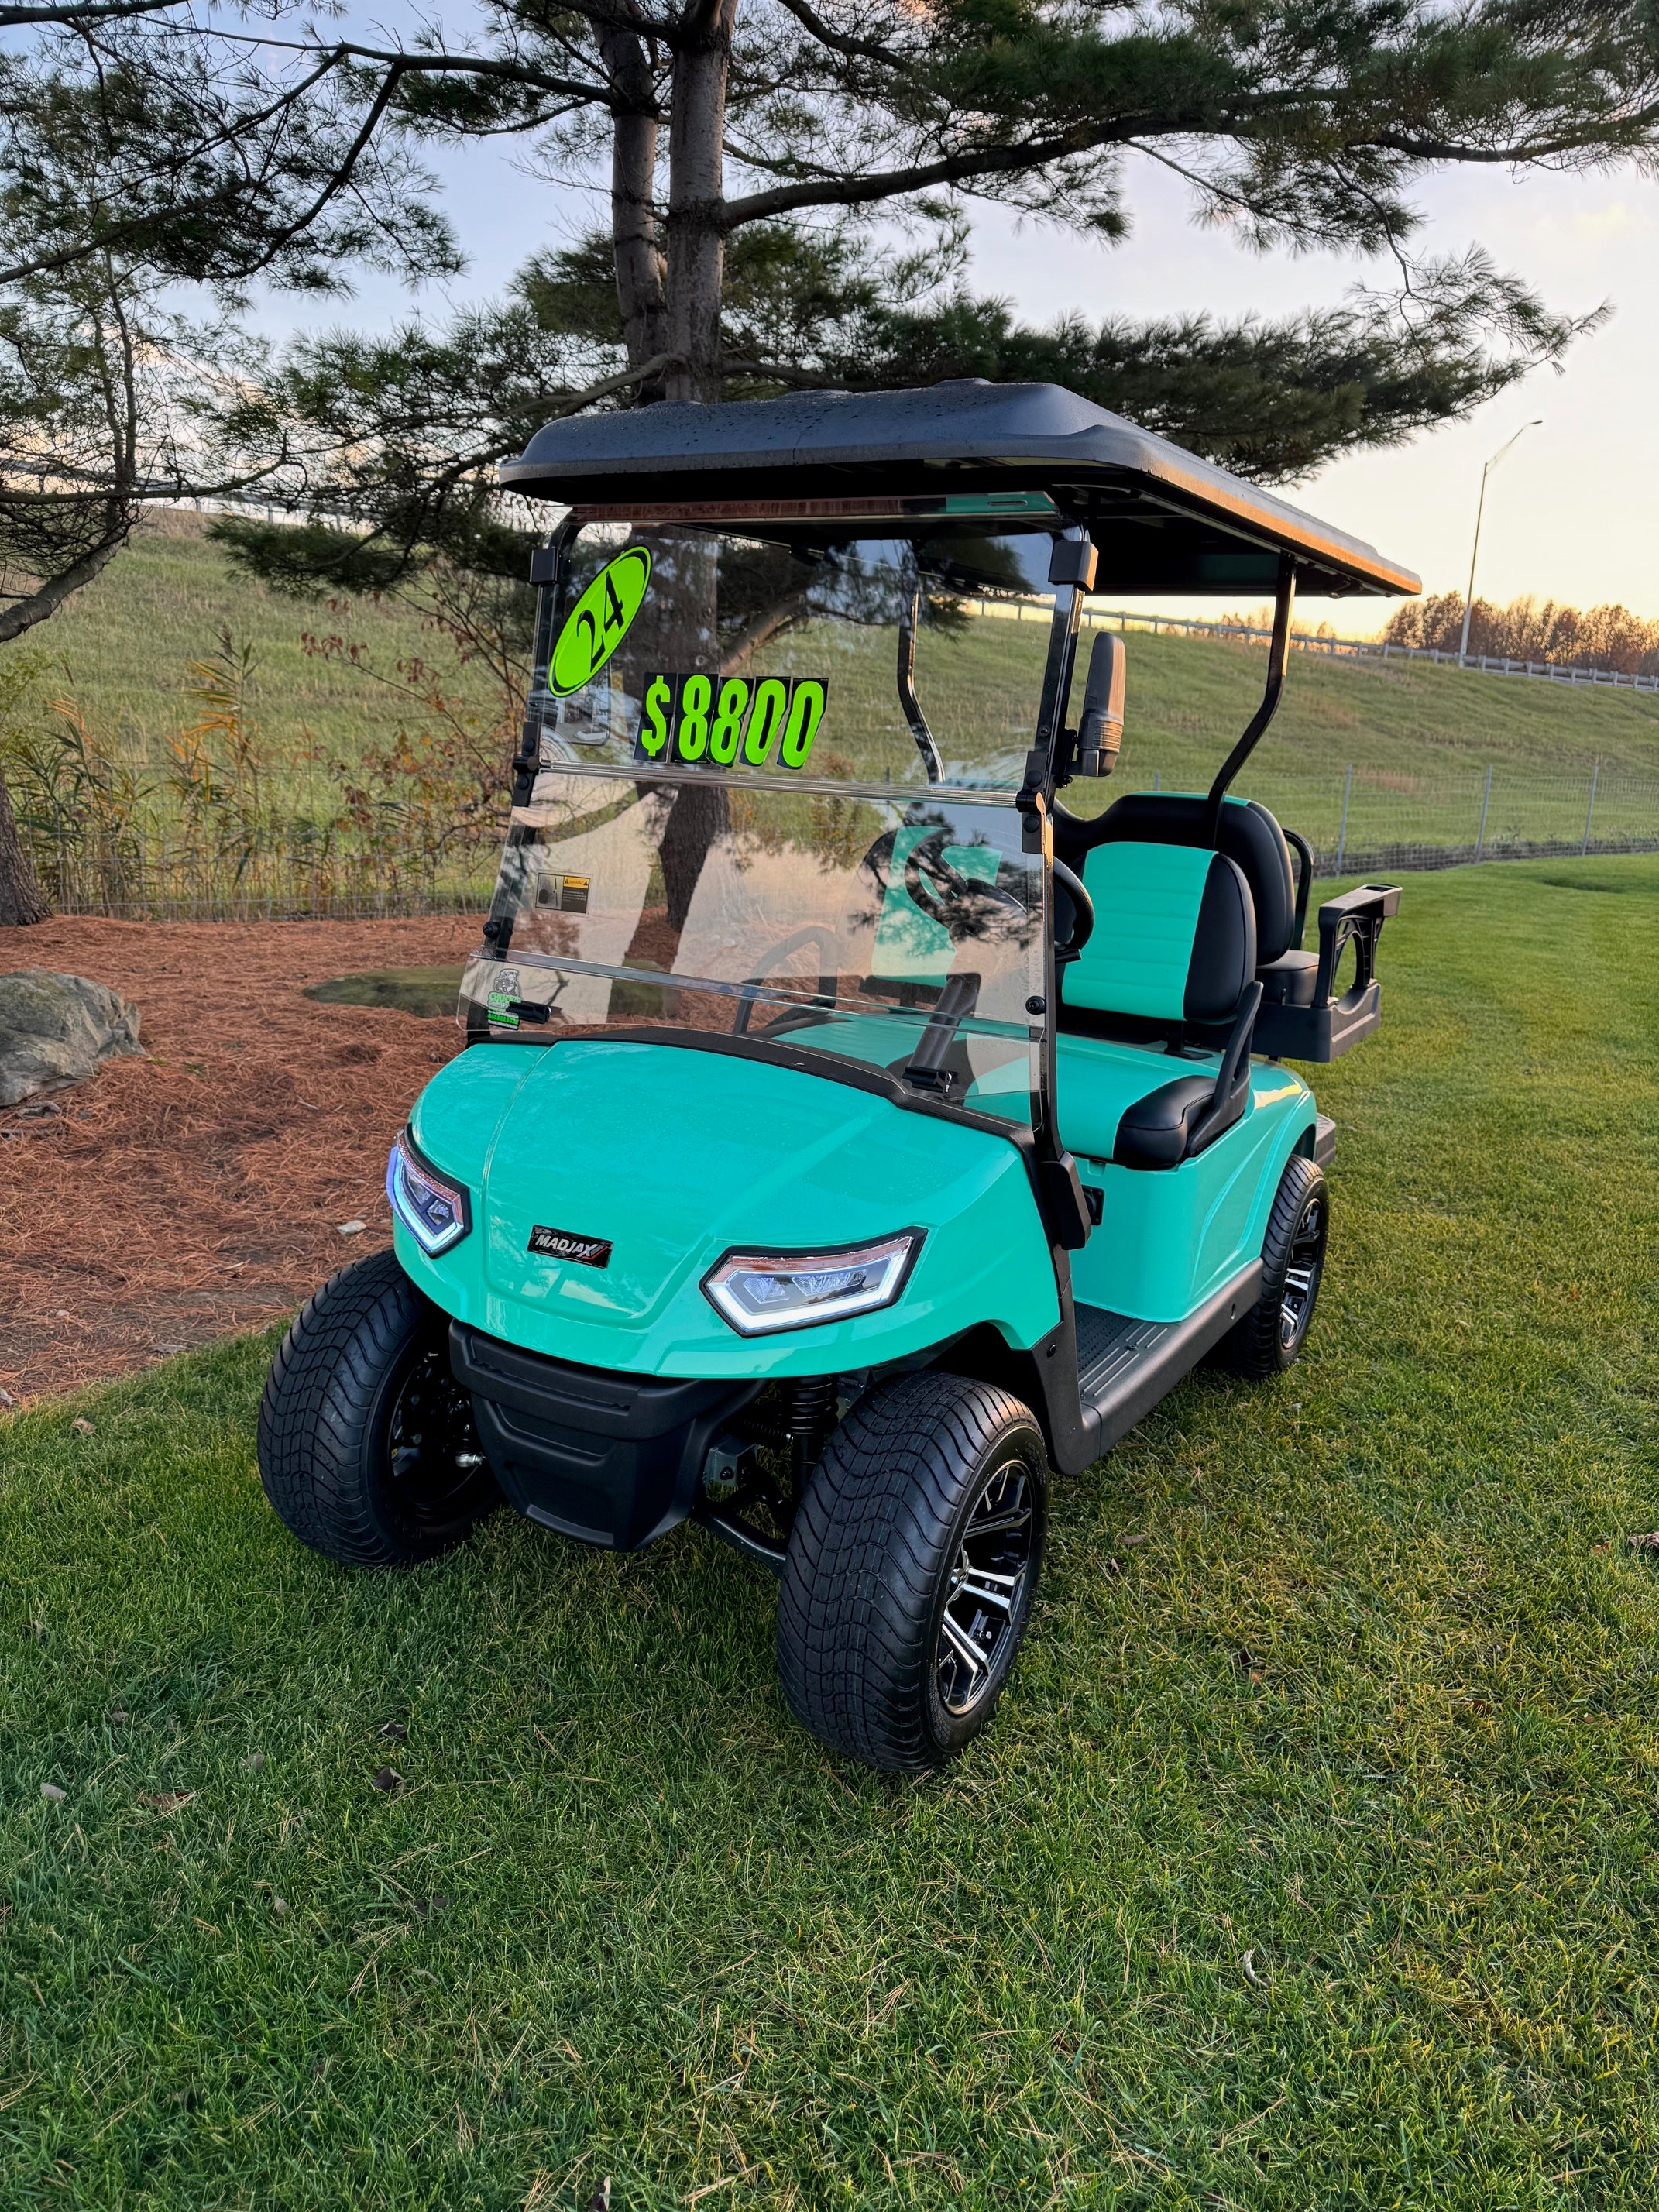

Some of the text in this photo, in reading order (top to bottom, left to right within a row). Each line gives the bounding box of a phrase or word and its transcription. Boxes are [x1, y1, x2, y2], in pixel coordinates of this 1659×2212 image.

[576, 570, 624, 673] 24
[641, 675, 824, 768] $8800
[534, 1234, 599, 1258] MADJAX
